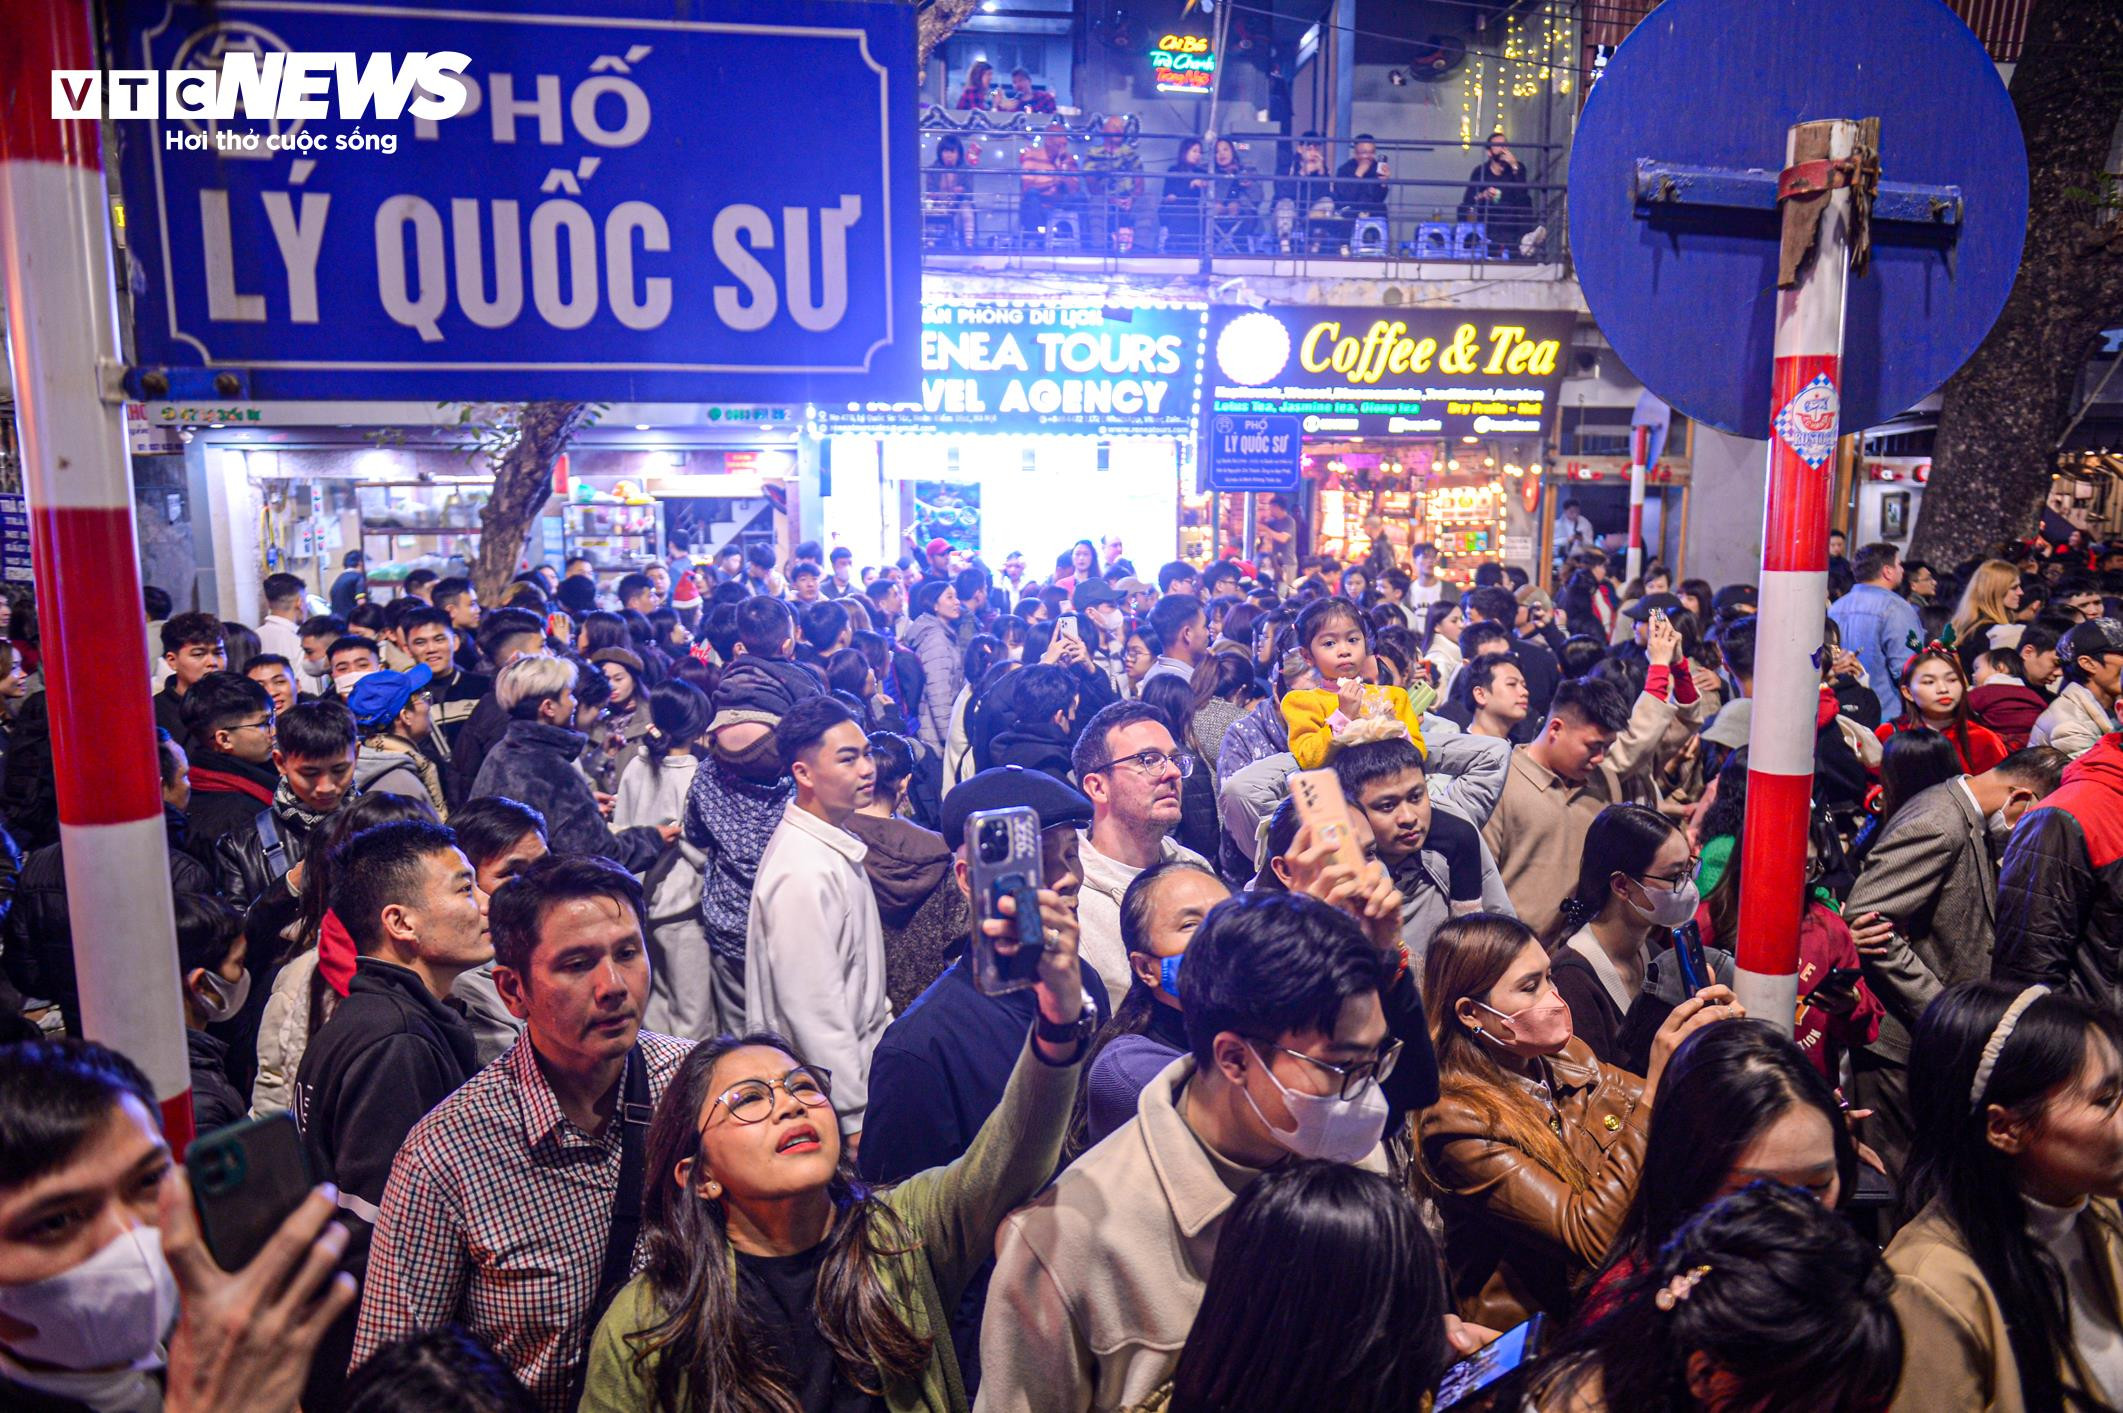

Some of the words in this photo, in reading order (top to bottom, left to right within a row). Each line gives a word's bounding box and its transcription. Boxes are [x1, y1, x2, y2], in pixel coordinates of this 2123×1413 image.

[200, 159, 331, 323] LÝ
[375, 156, 673, 342] QUỐC
[712, 194, 862, 332] SƯ
[957, 304, 1024, 325] PHÒNG
[1030, 309, 1056, 325] DU
[921, 331, 1029, 372] ENEA
[1036, 331, 1182, 374] TOURS
[1300, 320, 1438, 384] Coffee
[1439, 323, 1480, 375] &
[1481, 326, 1561, 376] Tea
[999, 379, 1168, 414] AGENCY
[1245, 416, 1269, 431] PHỐ
[1224, 431, 1239, 453] LÝ
[1241, 430, 1270, 455] QUỐC
[1272, 433, 1290, 454] SƯ
